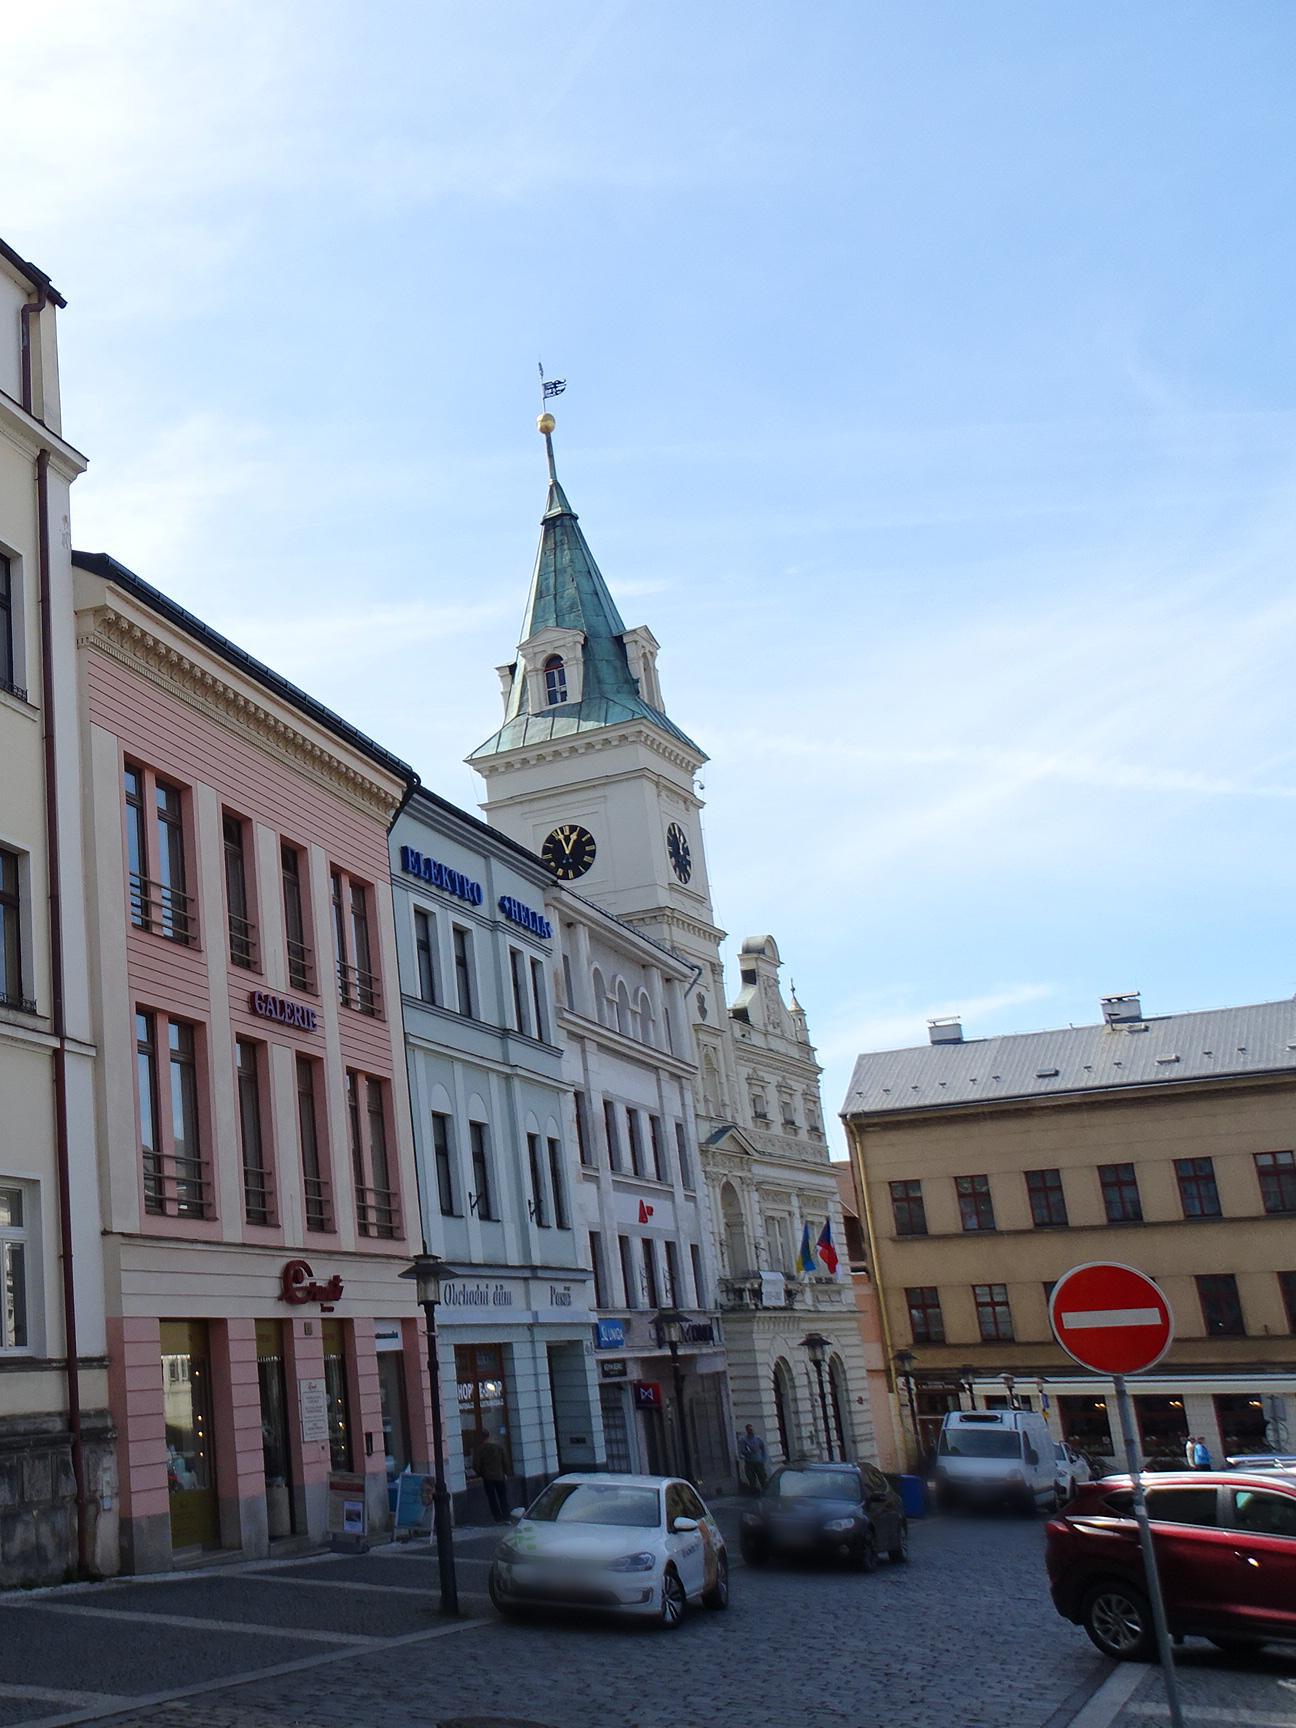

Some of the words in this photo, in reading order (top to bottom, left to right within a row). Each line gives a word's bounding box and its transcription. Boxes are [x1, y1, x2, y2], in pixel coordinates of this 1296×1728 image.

[402, 846, 483, 907] ELEKTRO
[506, 897, 549, 939] HELIA
[254, 989, 318, 1033] GALERIE
